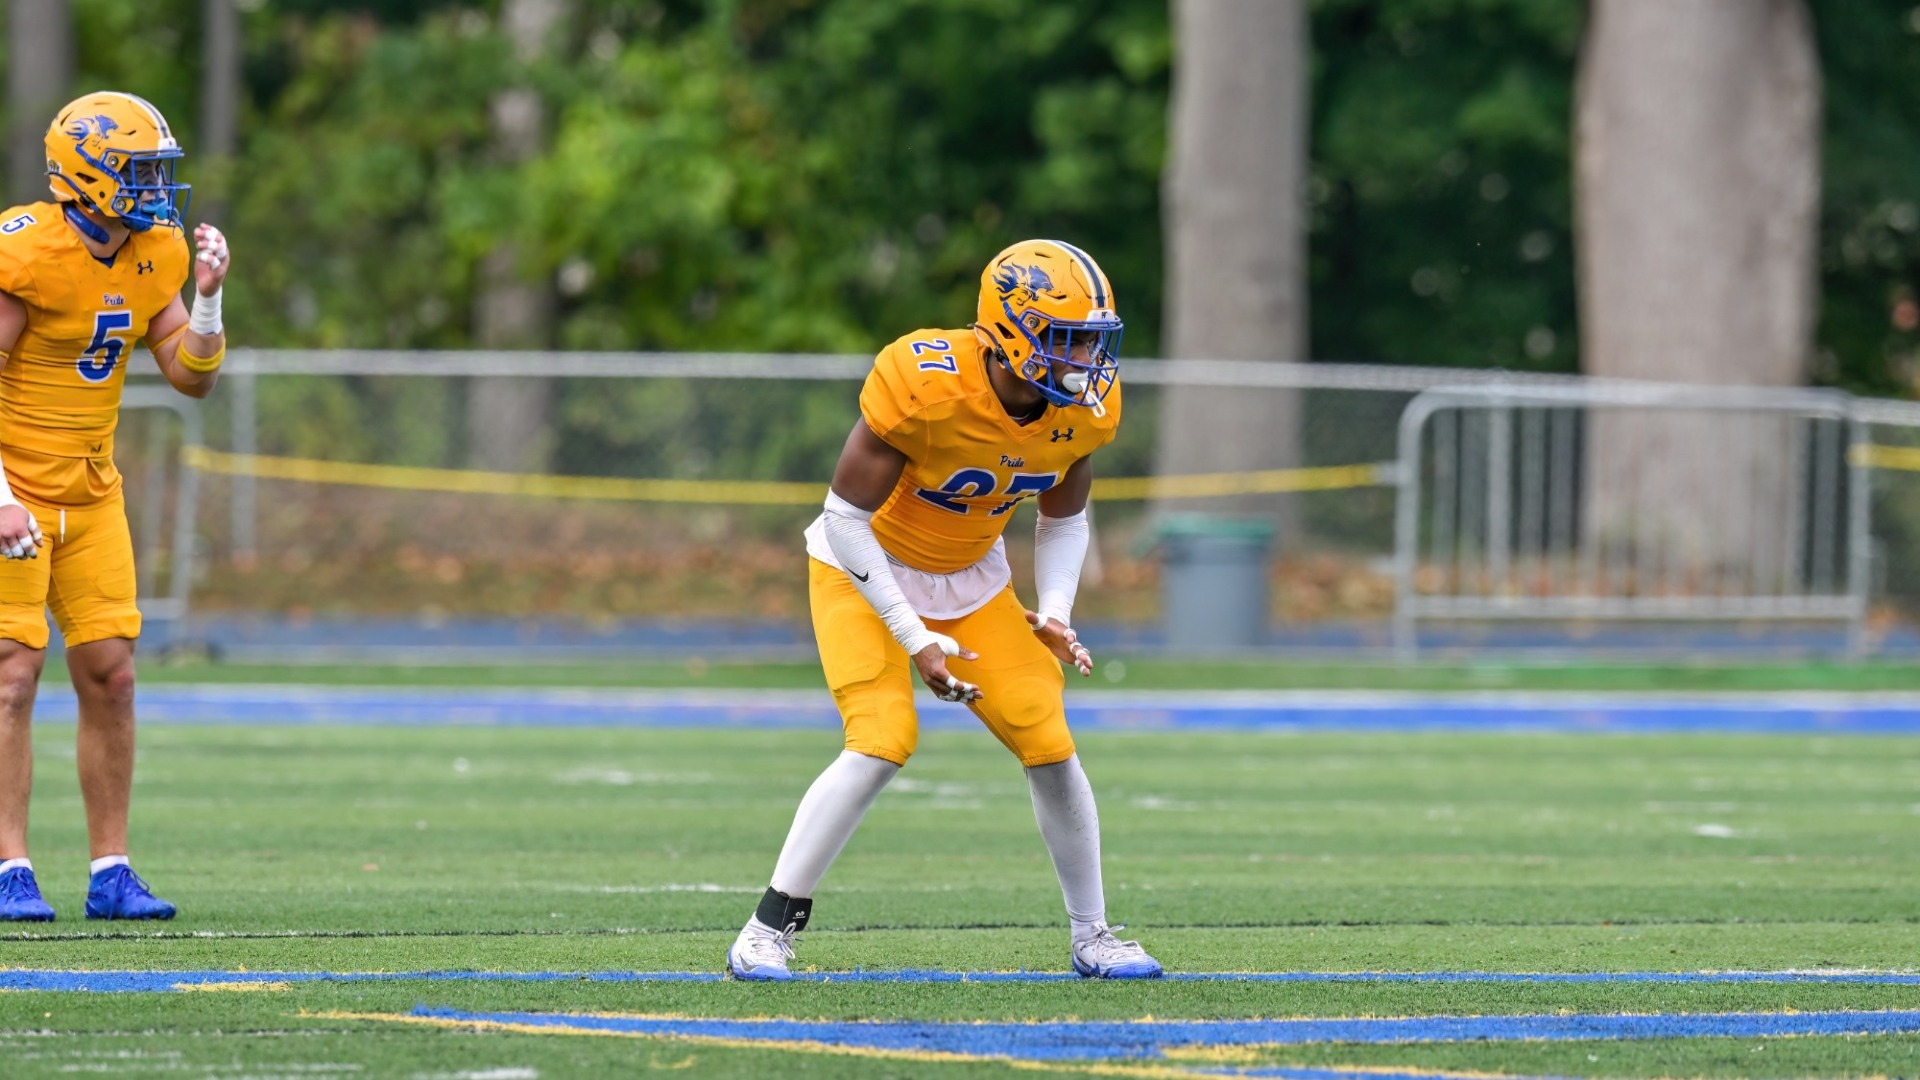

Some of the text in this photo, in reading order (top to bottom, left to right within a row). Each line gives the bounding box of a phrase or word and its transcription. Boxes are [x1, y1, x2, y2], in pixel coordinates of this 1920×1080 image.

[0, 213, 37, 235] 5
[77, 310, 132, 384] 5
[910, 338, 960, 374] 27
[999, 454, 1026, 468] Pride
[913, 467, 1060, 518] 27
